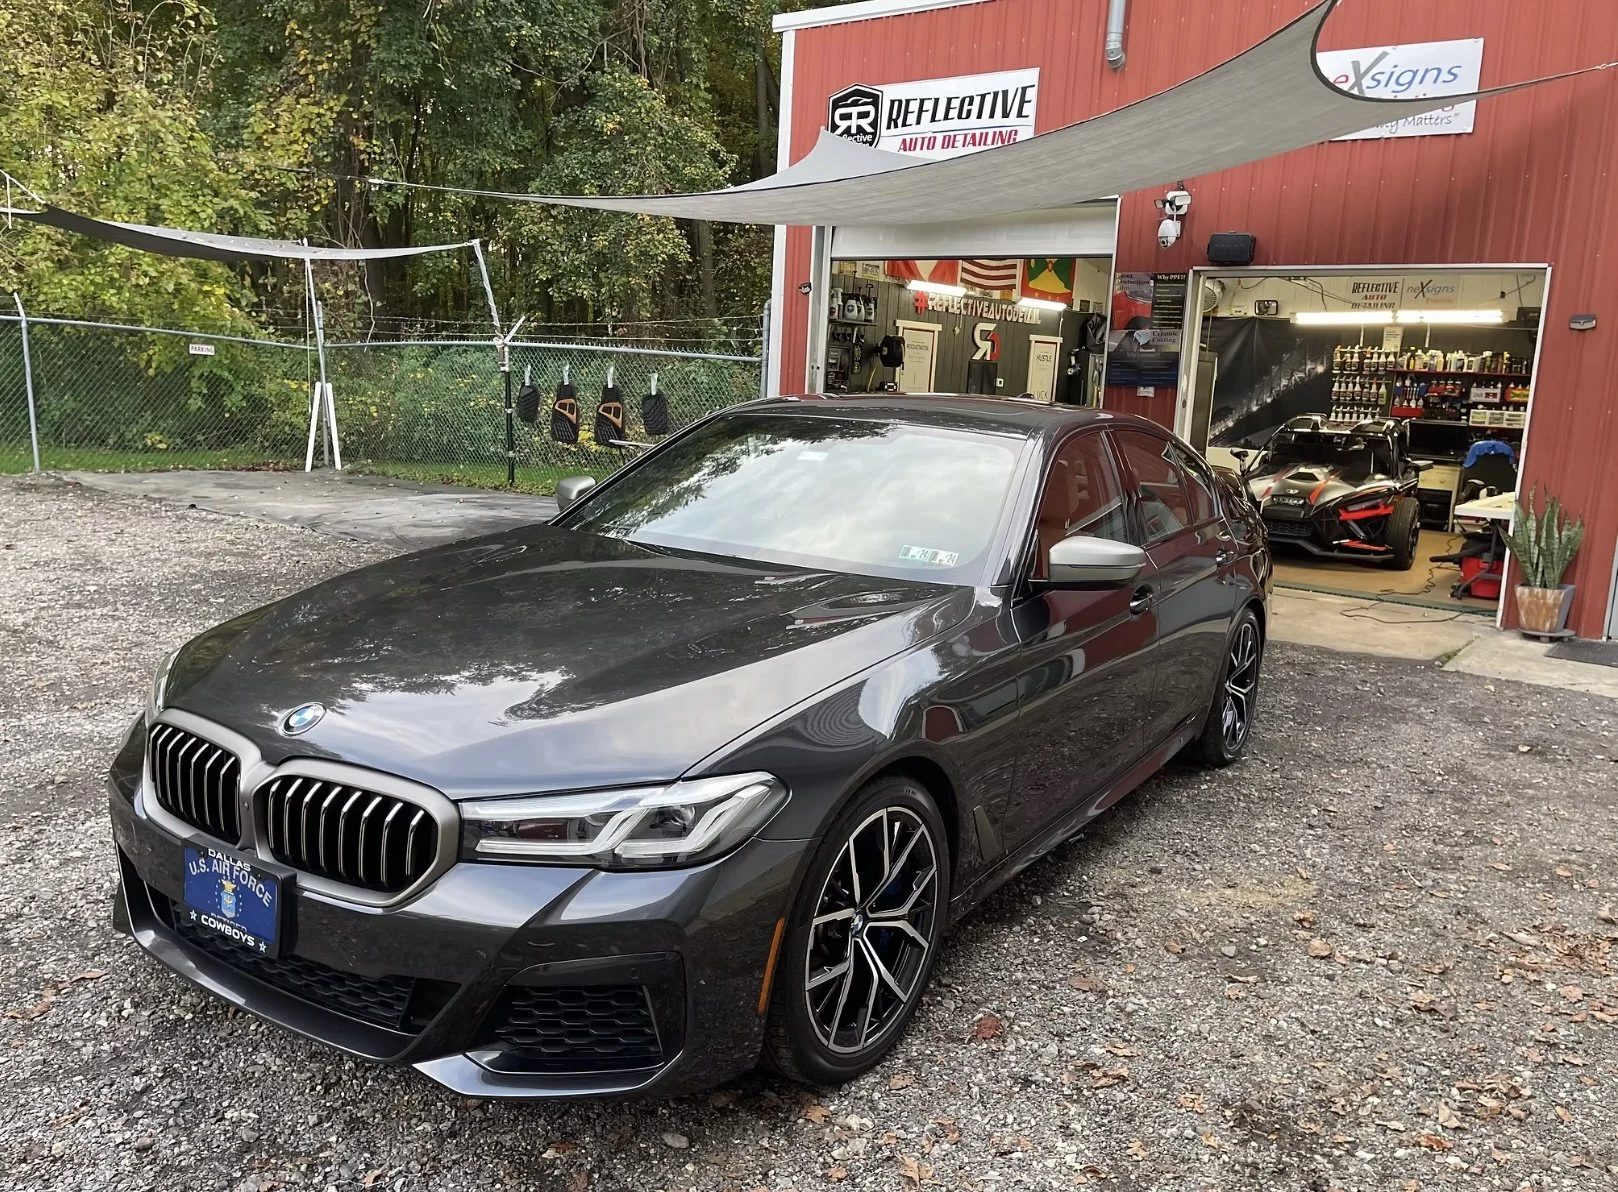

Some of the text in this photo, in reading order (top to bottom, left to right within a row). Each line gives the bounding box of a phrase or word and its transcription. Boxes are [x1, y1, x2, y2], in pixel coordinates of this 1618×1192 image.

[1333, 50, 1462, 95] eXsigns
[886, 84, 1036, 131] REFLECTIVE
[898, 129, 1019, 152] AUTO DETAILING
[1351, 281, 1400, 294] REFLECTIVE
[190, 345, 214, 353] PARKING
[208, 848, 251, 872] DALLAS
[189, 858, 273, 908] U.S. AIR FORCE
[201, 914, 255, 947] COWBOYS
